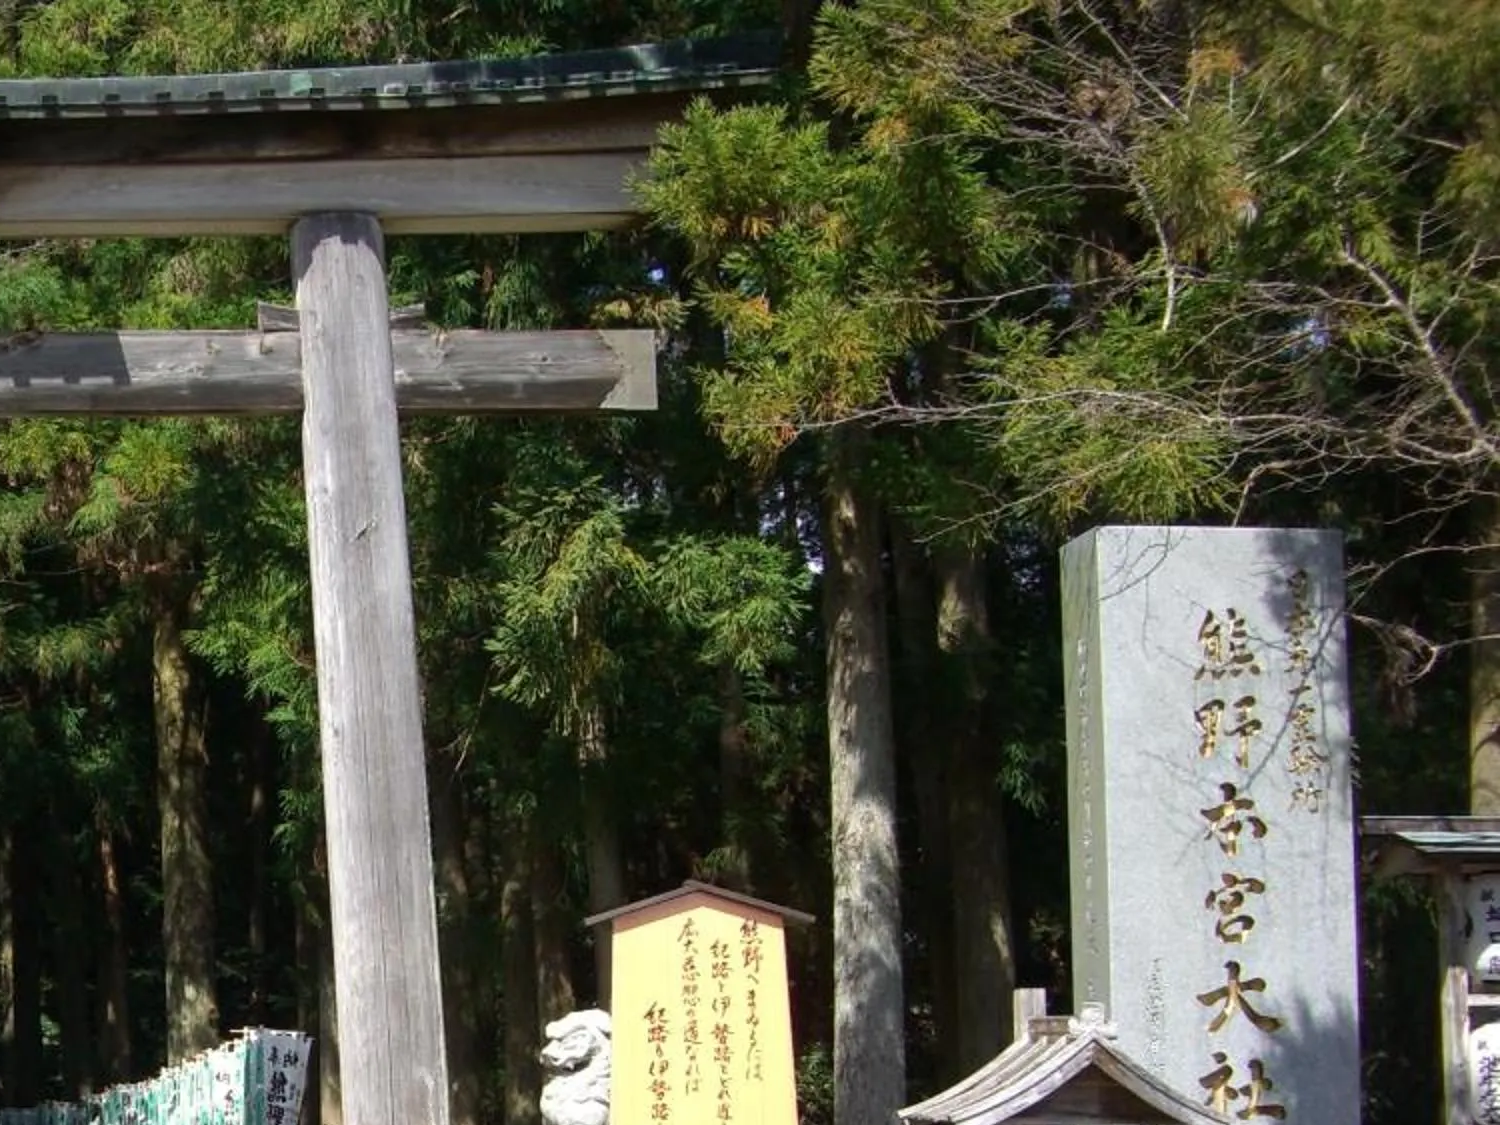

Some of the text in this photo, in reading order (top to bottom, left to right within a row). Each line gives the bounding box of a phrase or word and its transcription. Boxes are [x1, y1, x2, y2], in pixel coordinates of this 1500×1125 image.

[1193, 607, 1286, 1121] 熊野本宮大社
